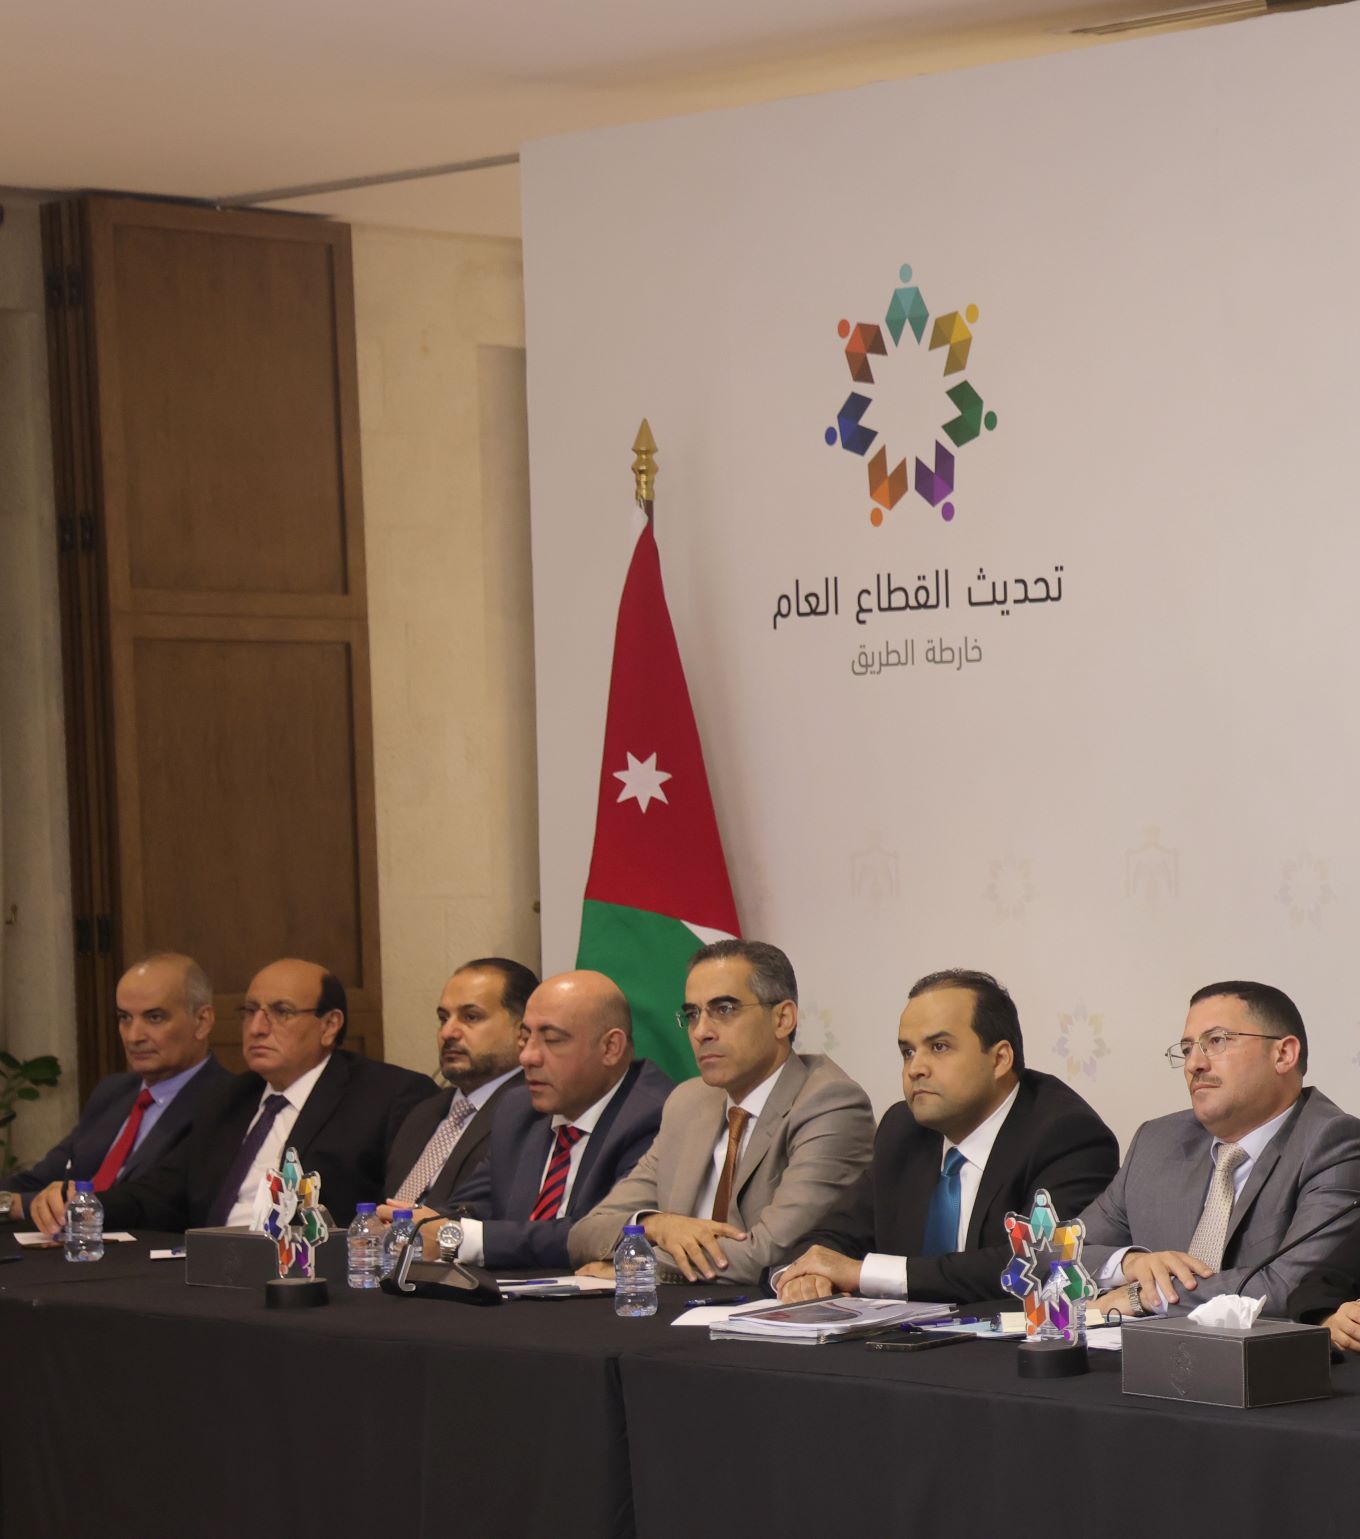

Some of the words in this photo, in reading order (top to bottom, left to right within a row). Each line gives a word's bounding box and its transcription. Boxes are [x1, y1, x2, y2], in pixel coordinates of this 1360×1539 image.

[772, 575, 839, 631] العام
[855, 568, 950, 625] القطاع
[967, 565, 1064, 616] تحديث
[851, 638, 915, 676] الطريق
[924, 635, 983, 672] خارطة
